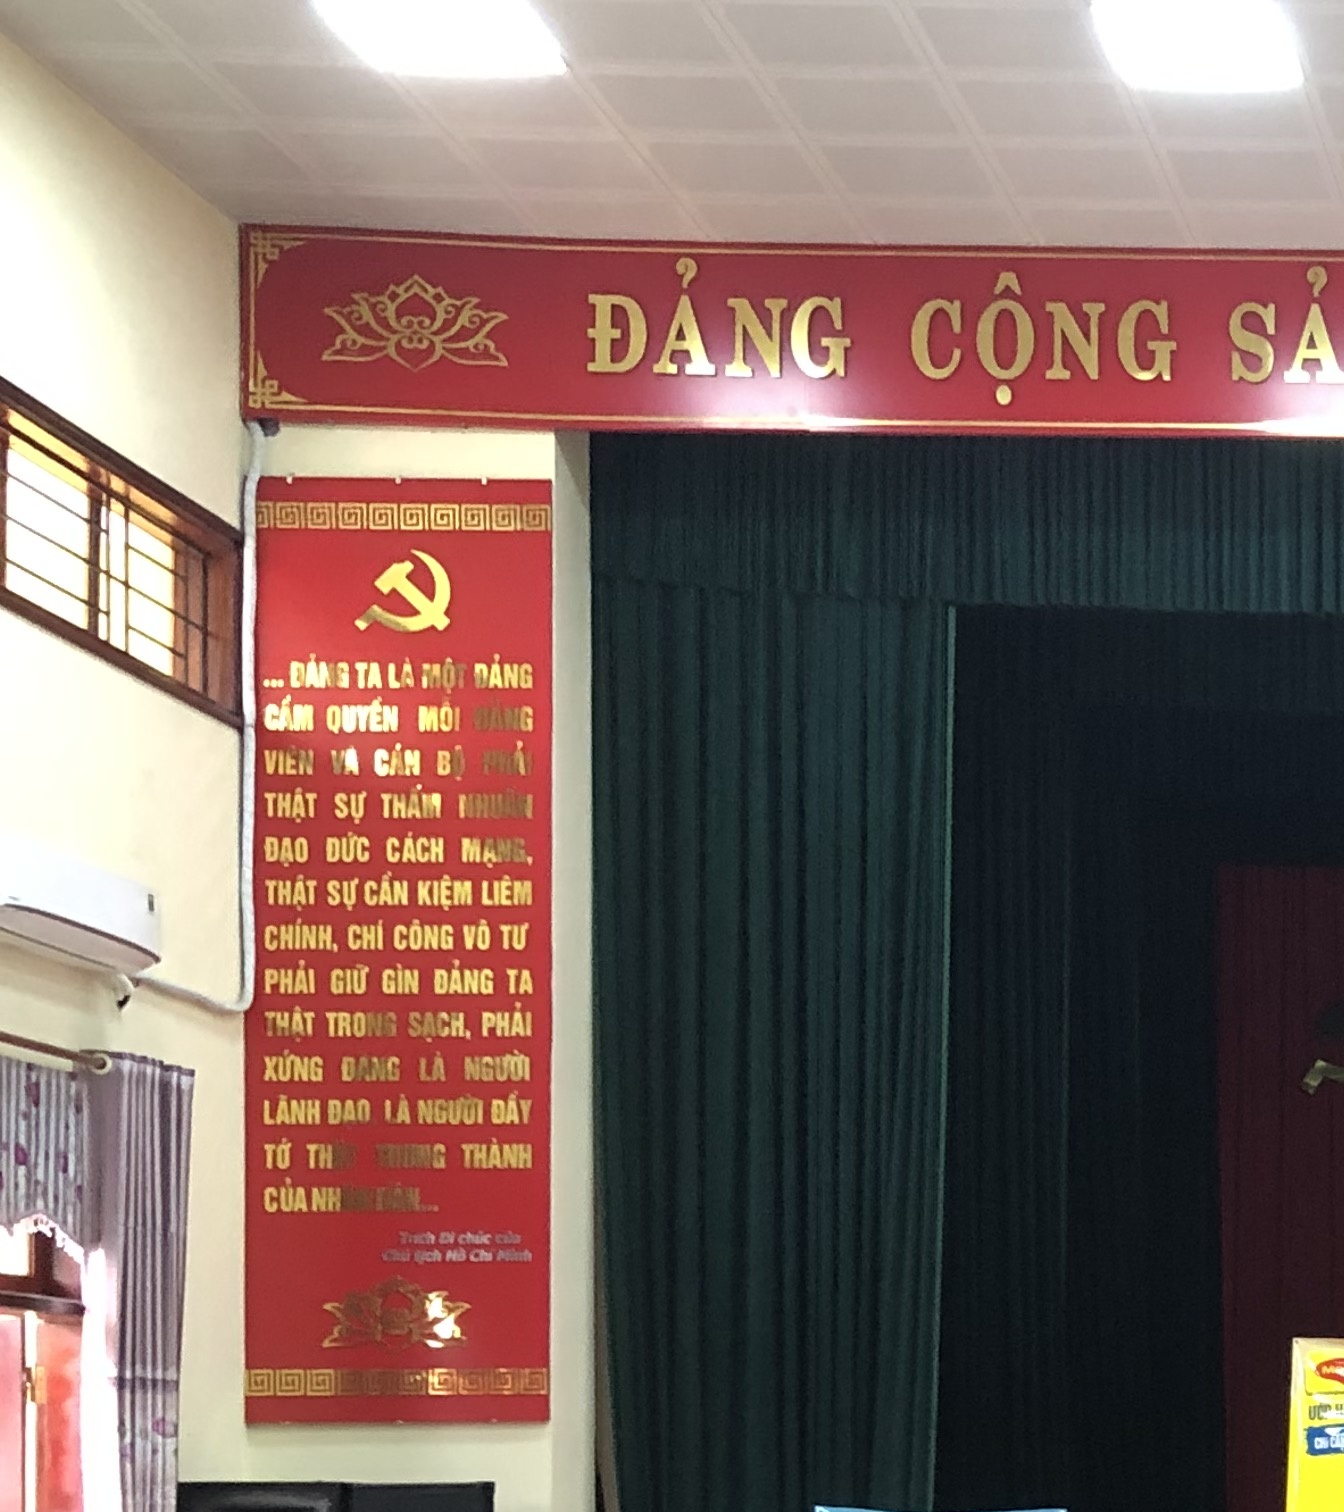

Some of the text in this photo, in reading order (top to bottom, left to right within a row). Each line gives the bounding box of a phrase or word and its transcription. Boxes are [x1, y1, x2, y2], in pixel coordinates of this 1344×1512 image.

[587, 258, 852, 379] ĐẢNG
[911, 271, 1177, 406] CỘNG
[289, 653, 349, 689] ĐẢNG
[355, 662, 382, 689] TA
[388, 657, 414, 689] LÀ
[474, 653, 533, 689] ĐẢNG
[264, 745, 314, 775] VIÊN
[264, 787, 318, 823] THẬT
[334, 790, 367, 824] SỰ
[264, 837, 308, 867] ĐẠO
[325, 832, 370, 863] ĐỨC
[386, 831, 444, 863] CÁCH
[264, 874, 317, 911] THẬT
[326, 878, 359, 911] SỰ
[417, 874, 472, 911] KIỆM
[481, 874, 533, 906] LIÊM
[264, 918, 529, 952] CHÍNH, CHÍ CÔNG VÔ TƯ
[264, 958, 533, 995] PHẢI GIỮ GÌN ĐẢNG TA
[264, 1001, 532, 1043] THẬT TRONG SẠCH, PHẢI
[263, 1049, 323, 1082] XỨNG
[419, 1051, 446, 1082] LÀ
[464, 1049, 530, 1082] NGƯỜI
[263, 1094, 320, 1125] LÃNH
[384, 1094, 411, 1125] LÀ
[417, 1093, 484, 1126] NGƯỜI
[264, 1138, 292, 1170] TỚ
[461, 1138, 533, 1169] THÀNH
[264, 1177, 308, 1213] CỦA
